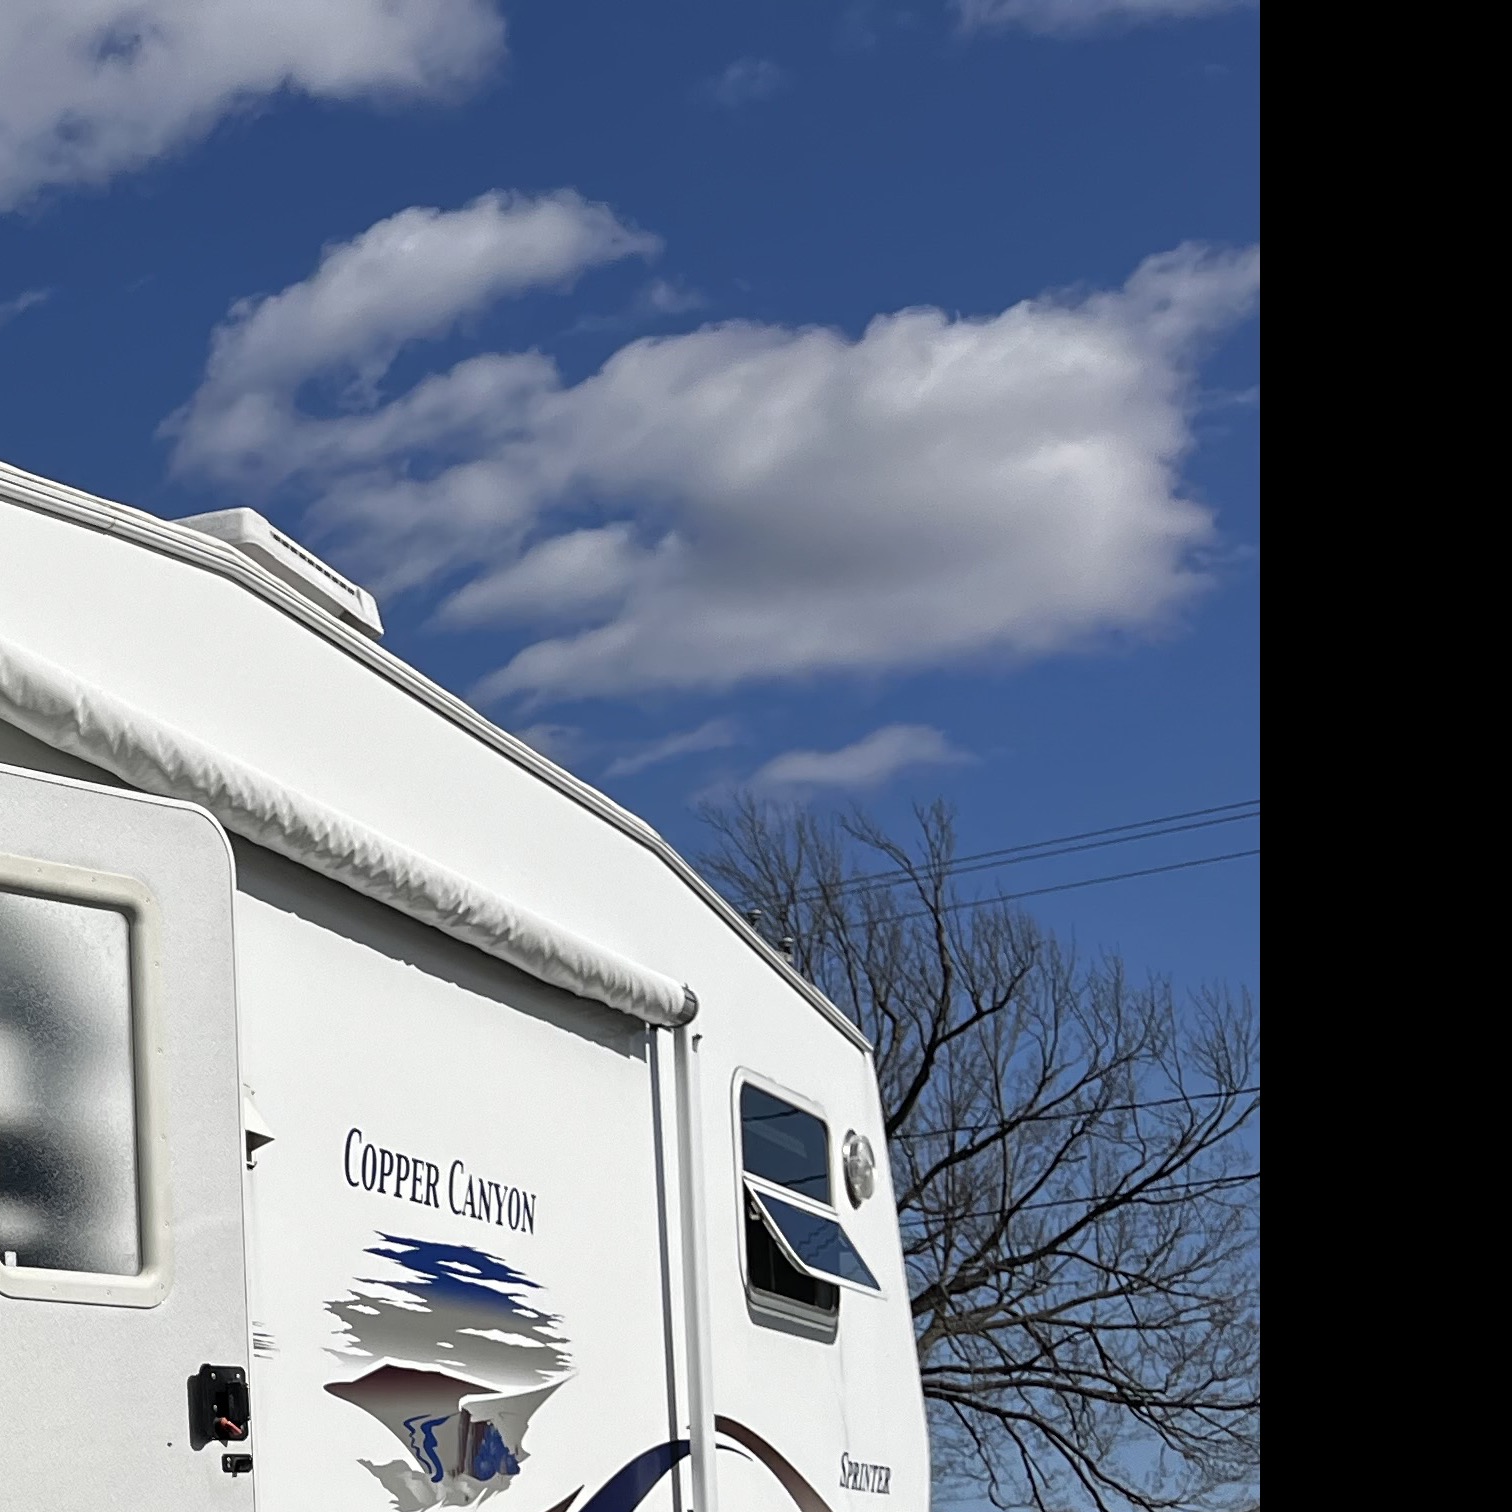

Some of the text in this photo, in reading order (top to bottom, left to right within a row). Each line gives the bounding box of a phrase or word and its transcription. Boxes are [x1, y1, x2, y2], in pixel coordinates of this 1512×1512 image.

[343, 1127, 537, 1236] COPPER CANYON
[839, 1451, 891, 1495] SPRINTER
